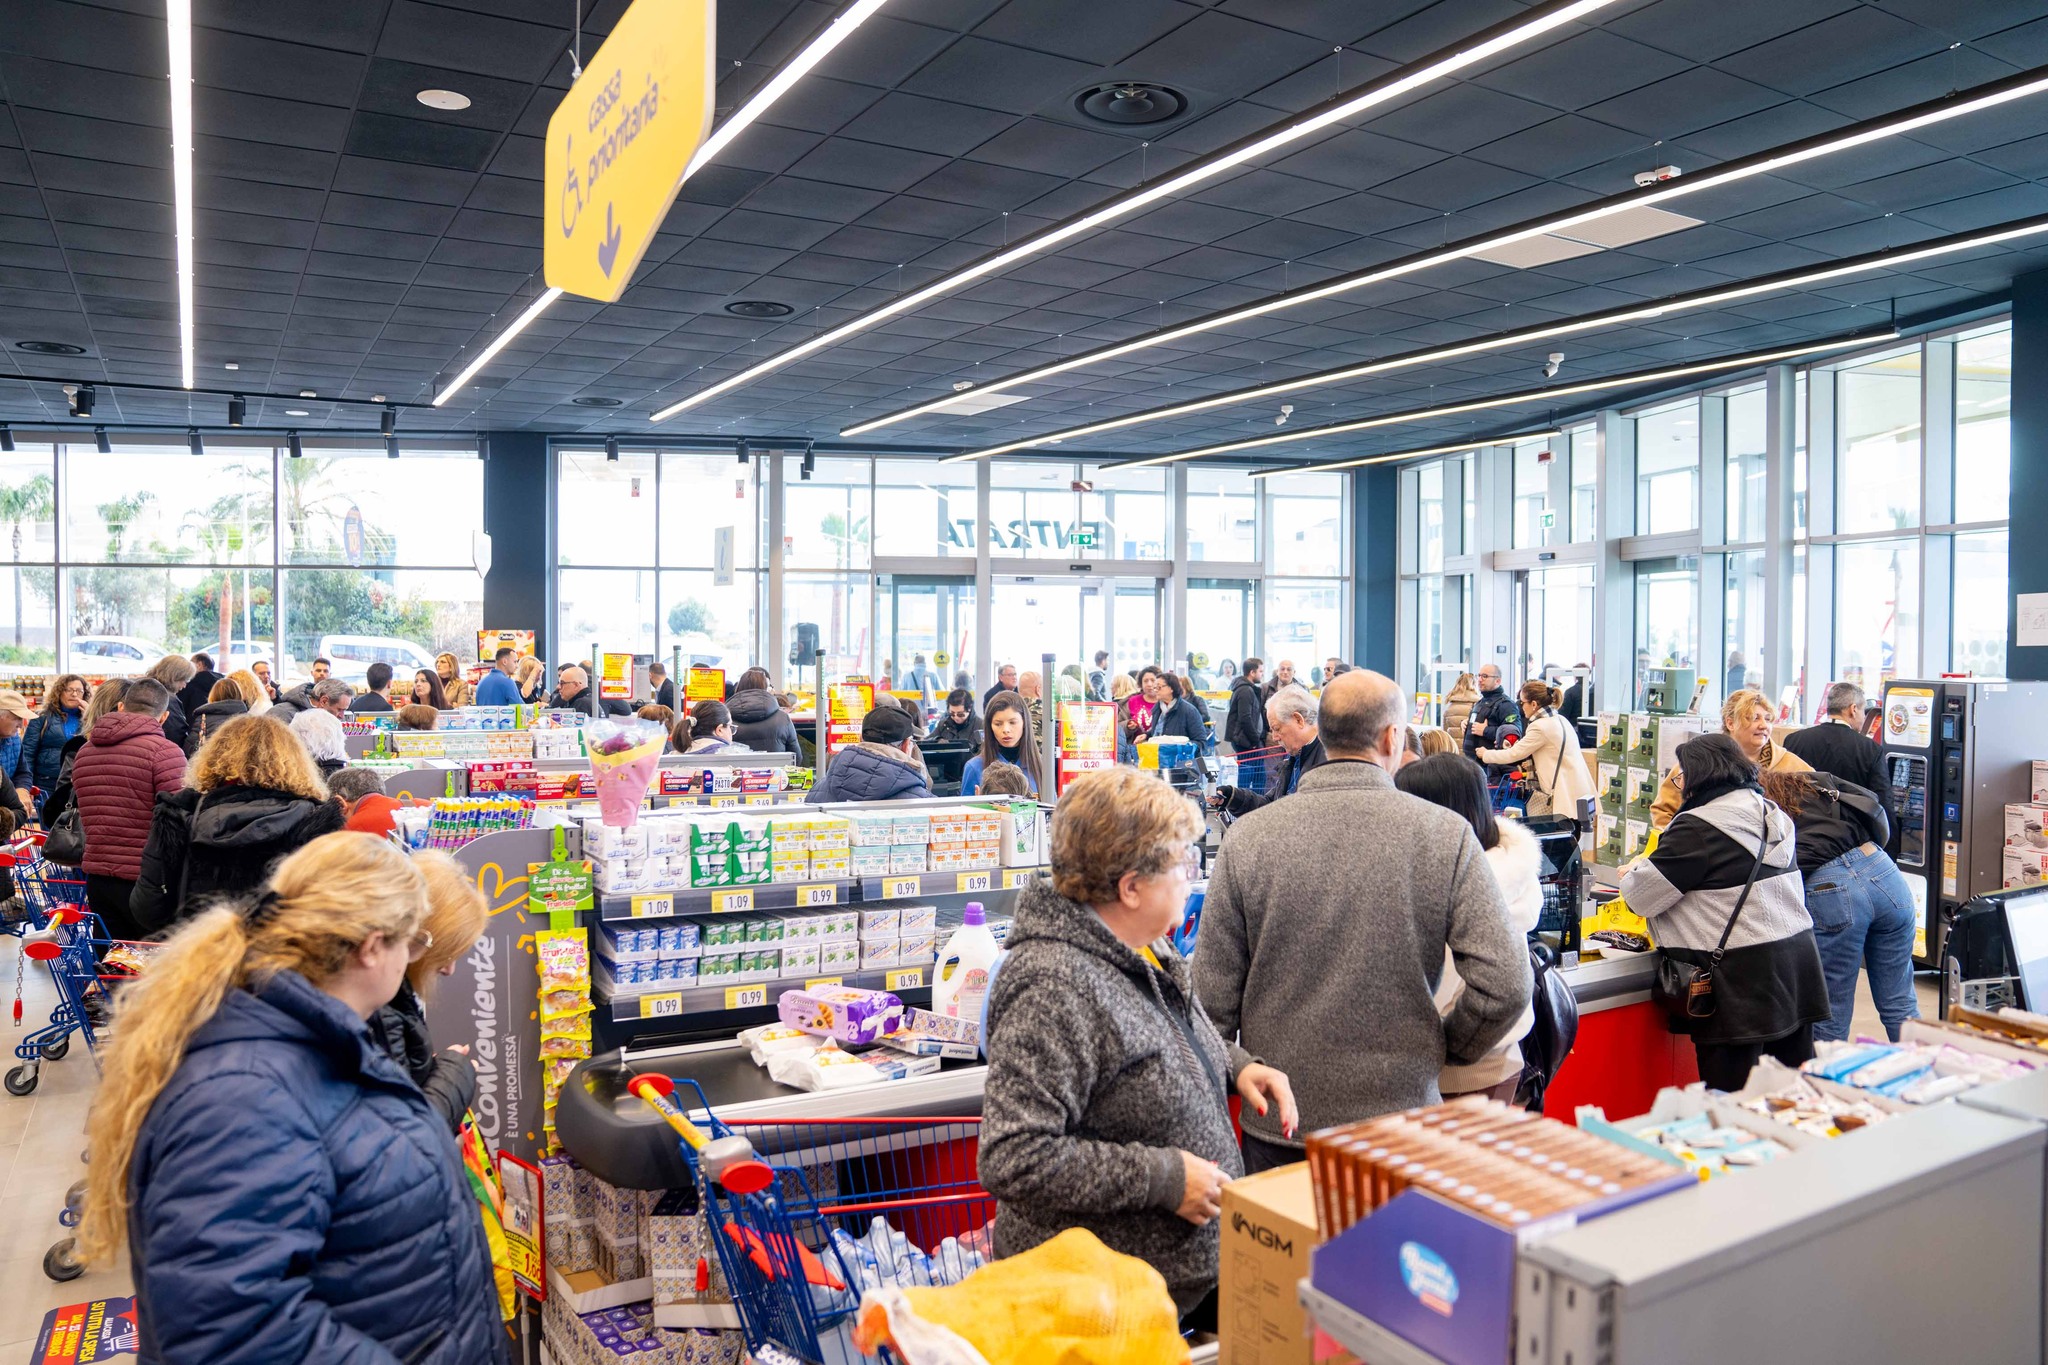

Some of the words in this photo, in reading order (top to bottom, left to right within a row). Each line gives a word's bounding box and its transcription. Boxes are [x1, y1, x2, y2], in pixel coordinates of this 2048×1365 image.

[588, 67, 621, 133] Cassa
[587, 73, 658, 203] prioritaria
[969, 877, 987, 890] 0,99
[1015, 873, 1029, 886] 0,8
[812, 890, 832, 903] 0,99
[897, 882, 916, 896] 0,99
[648, 900, 669, 915] 1,09
[728, 895, 749, 909] 1,09
[900, 973, 918, 989] 0,99
[741, 991, 762, 1006] 0,99
[656, 1000, 677, 1015] 0,99
[504, 1035, 518, 1101] PROMESSA
[506, 1101, 519, 1130] UNA
[504, 1130, 519, 1139] È
[91, 1301, 106, 1311] SU
[87, 1311, 105, 1331] TUTTA
[84, 1329, 100, 1340] LA
[78, 1340, 98, 1363] SPESA
